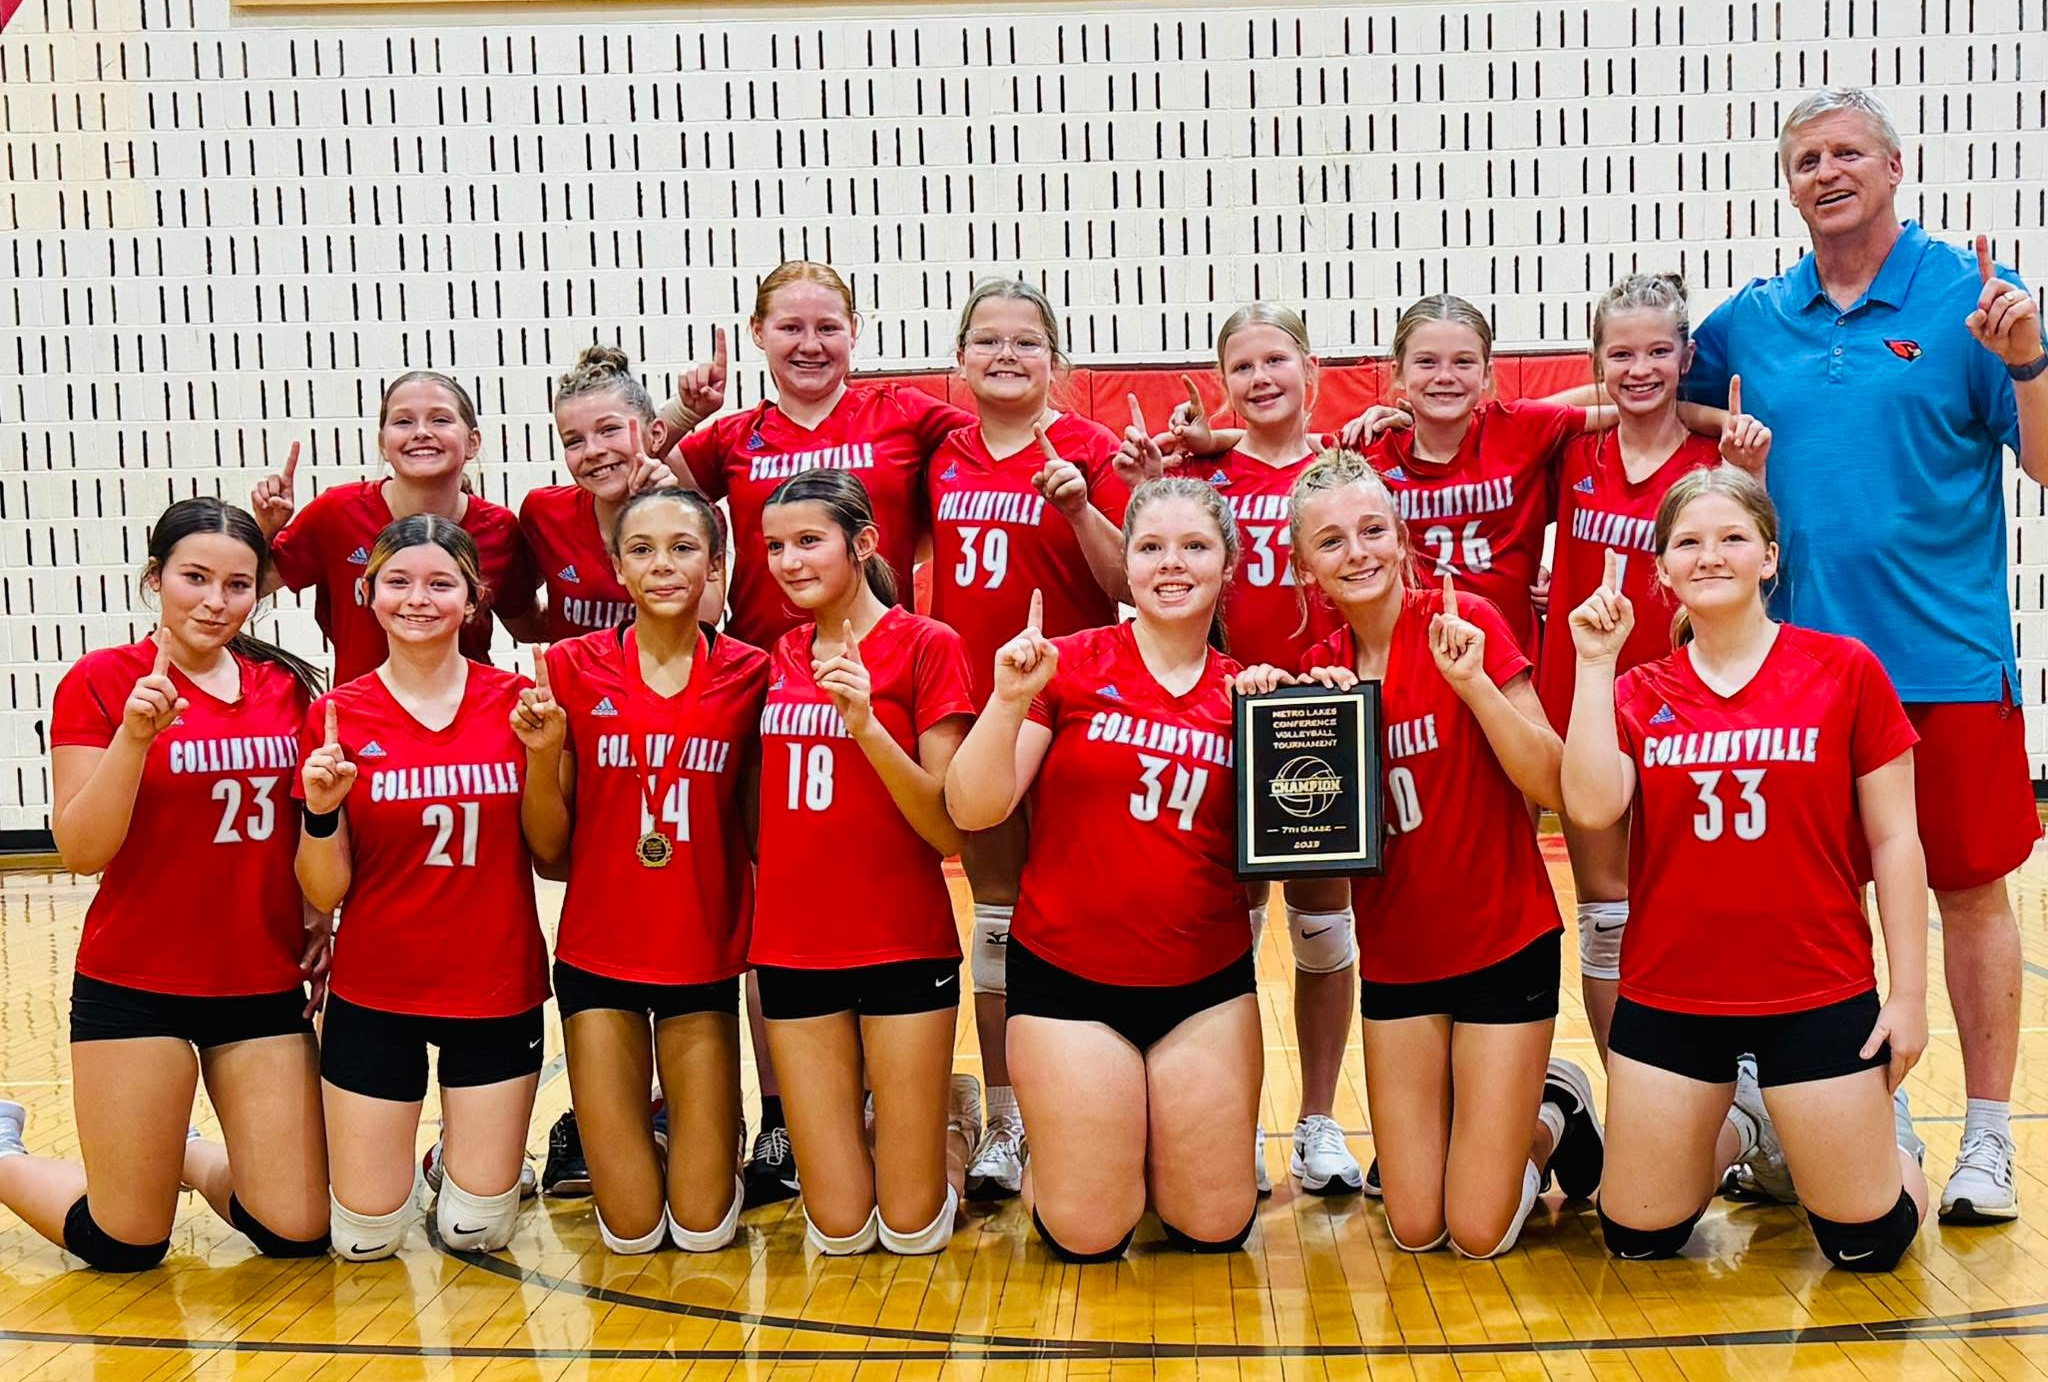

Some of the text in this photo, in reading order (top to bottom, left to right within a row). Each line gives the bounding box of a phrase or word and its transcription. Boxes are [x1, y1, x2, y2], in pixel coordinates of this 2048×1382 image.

[749, 442, 875, 481] COLLINSVILLE
[937, 490, 1046, 526] COLLINSVILLE
[955, 526, 1009, 590] 39
[1423, 519, 1492, 577] 26
[1272, 707, 1338, 718] METRO LAKES
[1272, 718, 1337, 728] CONFERENCE
[1275, 729, 1336, 739] VOLLEYBALL
[1272, 739, 1338, 749] TOURNAMENT
[1643, 726, 1820, 769] COLLINSVILLE
[371, 761, 519, 803] COLLINSVILLE
[785, 741, 834, 812] 18
[1129, 752, 1209, 832] 34
[1271, 779, 1341, 794] CHAMPION
[211, 775, 280, 844] 23
[1386, 766, 1424, 837] 0
[1687, 767, 1768, 842] 33
[422, 801, 480, 867] 21
